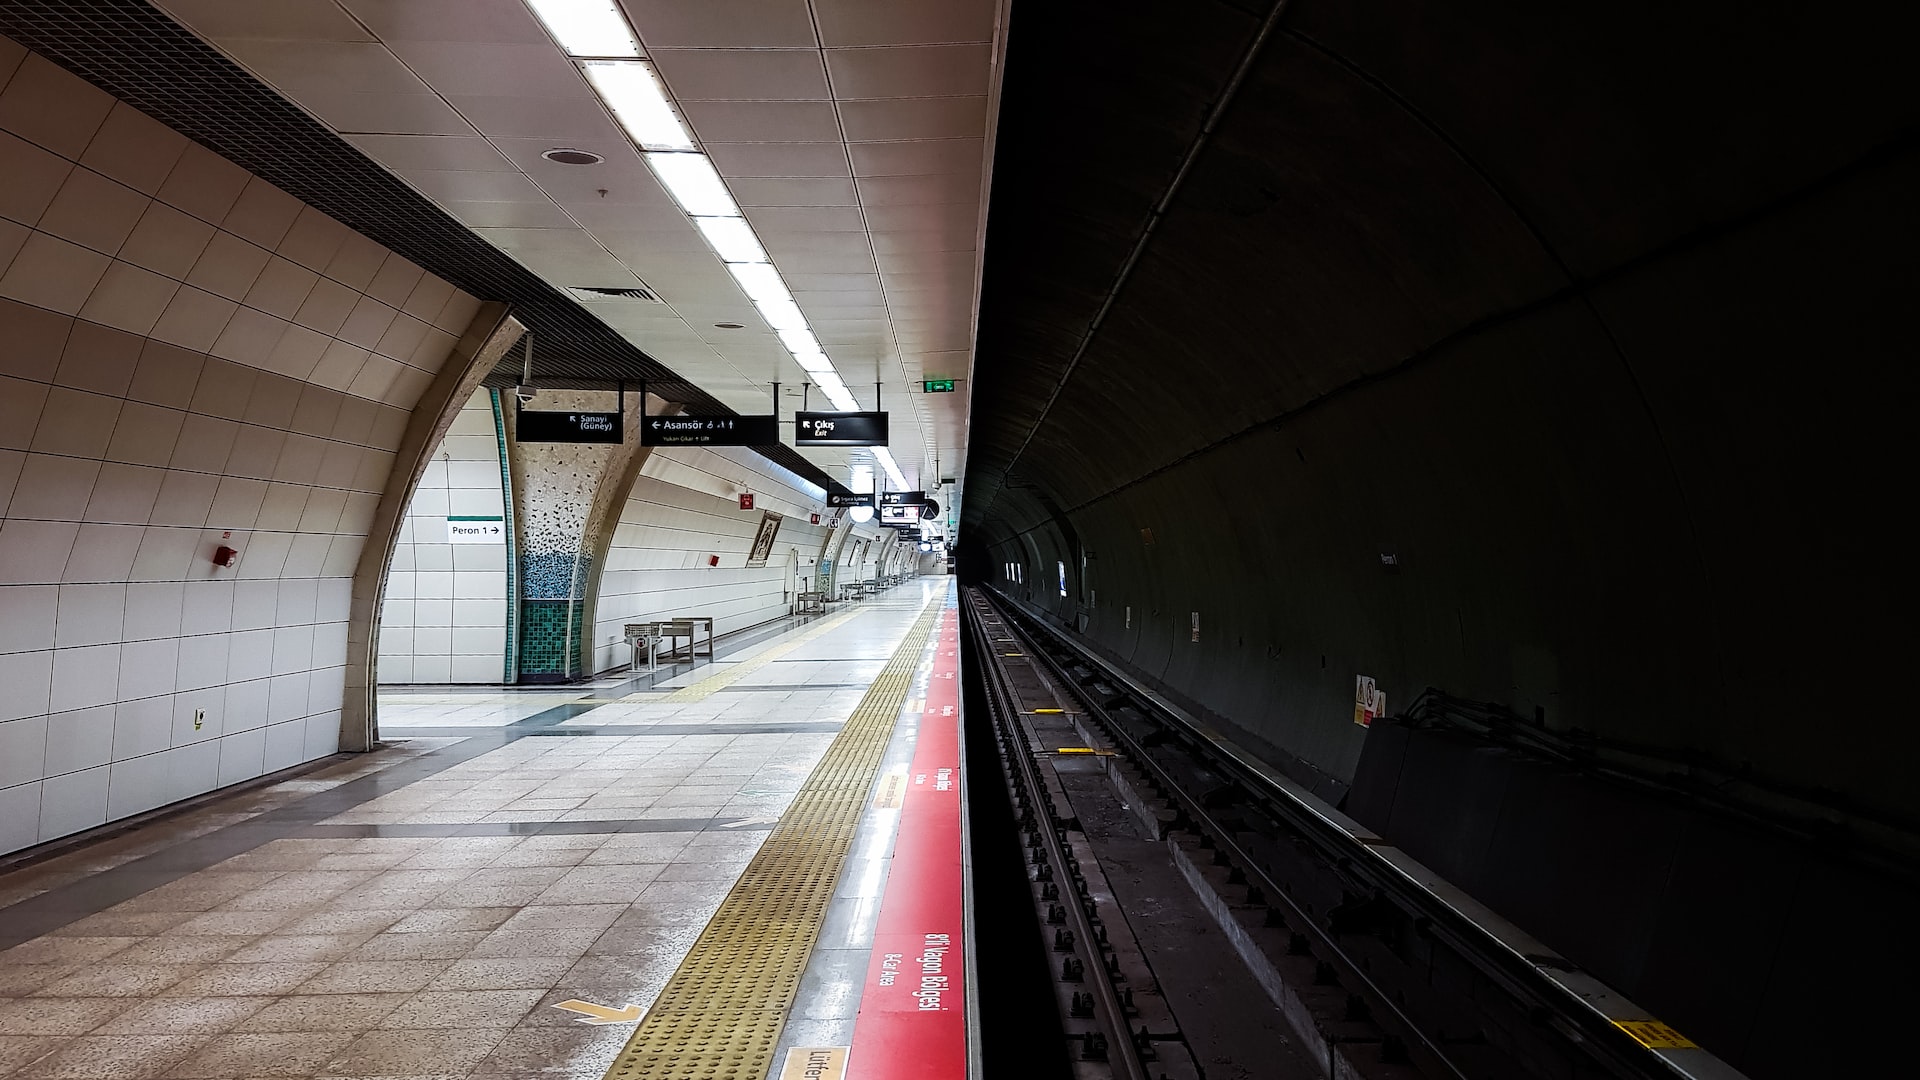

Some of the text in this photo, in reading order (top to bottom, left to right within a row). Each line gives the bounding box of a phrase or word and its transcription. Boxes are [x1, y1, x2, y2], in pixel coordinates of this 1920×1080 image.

[580, 414, 607, 423] Sanayi
[580, 422, 612, 431] (Güney)
[663, 420, 703, 430] Asansör
[452, 526, 487, 535] Peron 1
[915, 946, 949, 974] Vagon
[879, 953, 903, 986] 8-Car Area
[912, 976, 950, 1011] Bölgesi
